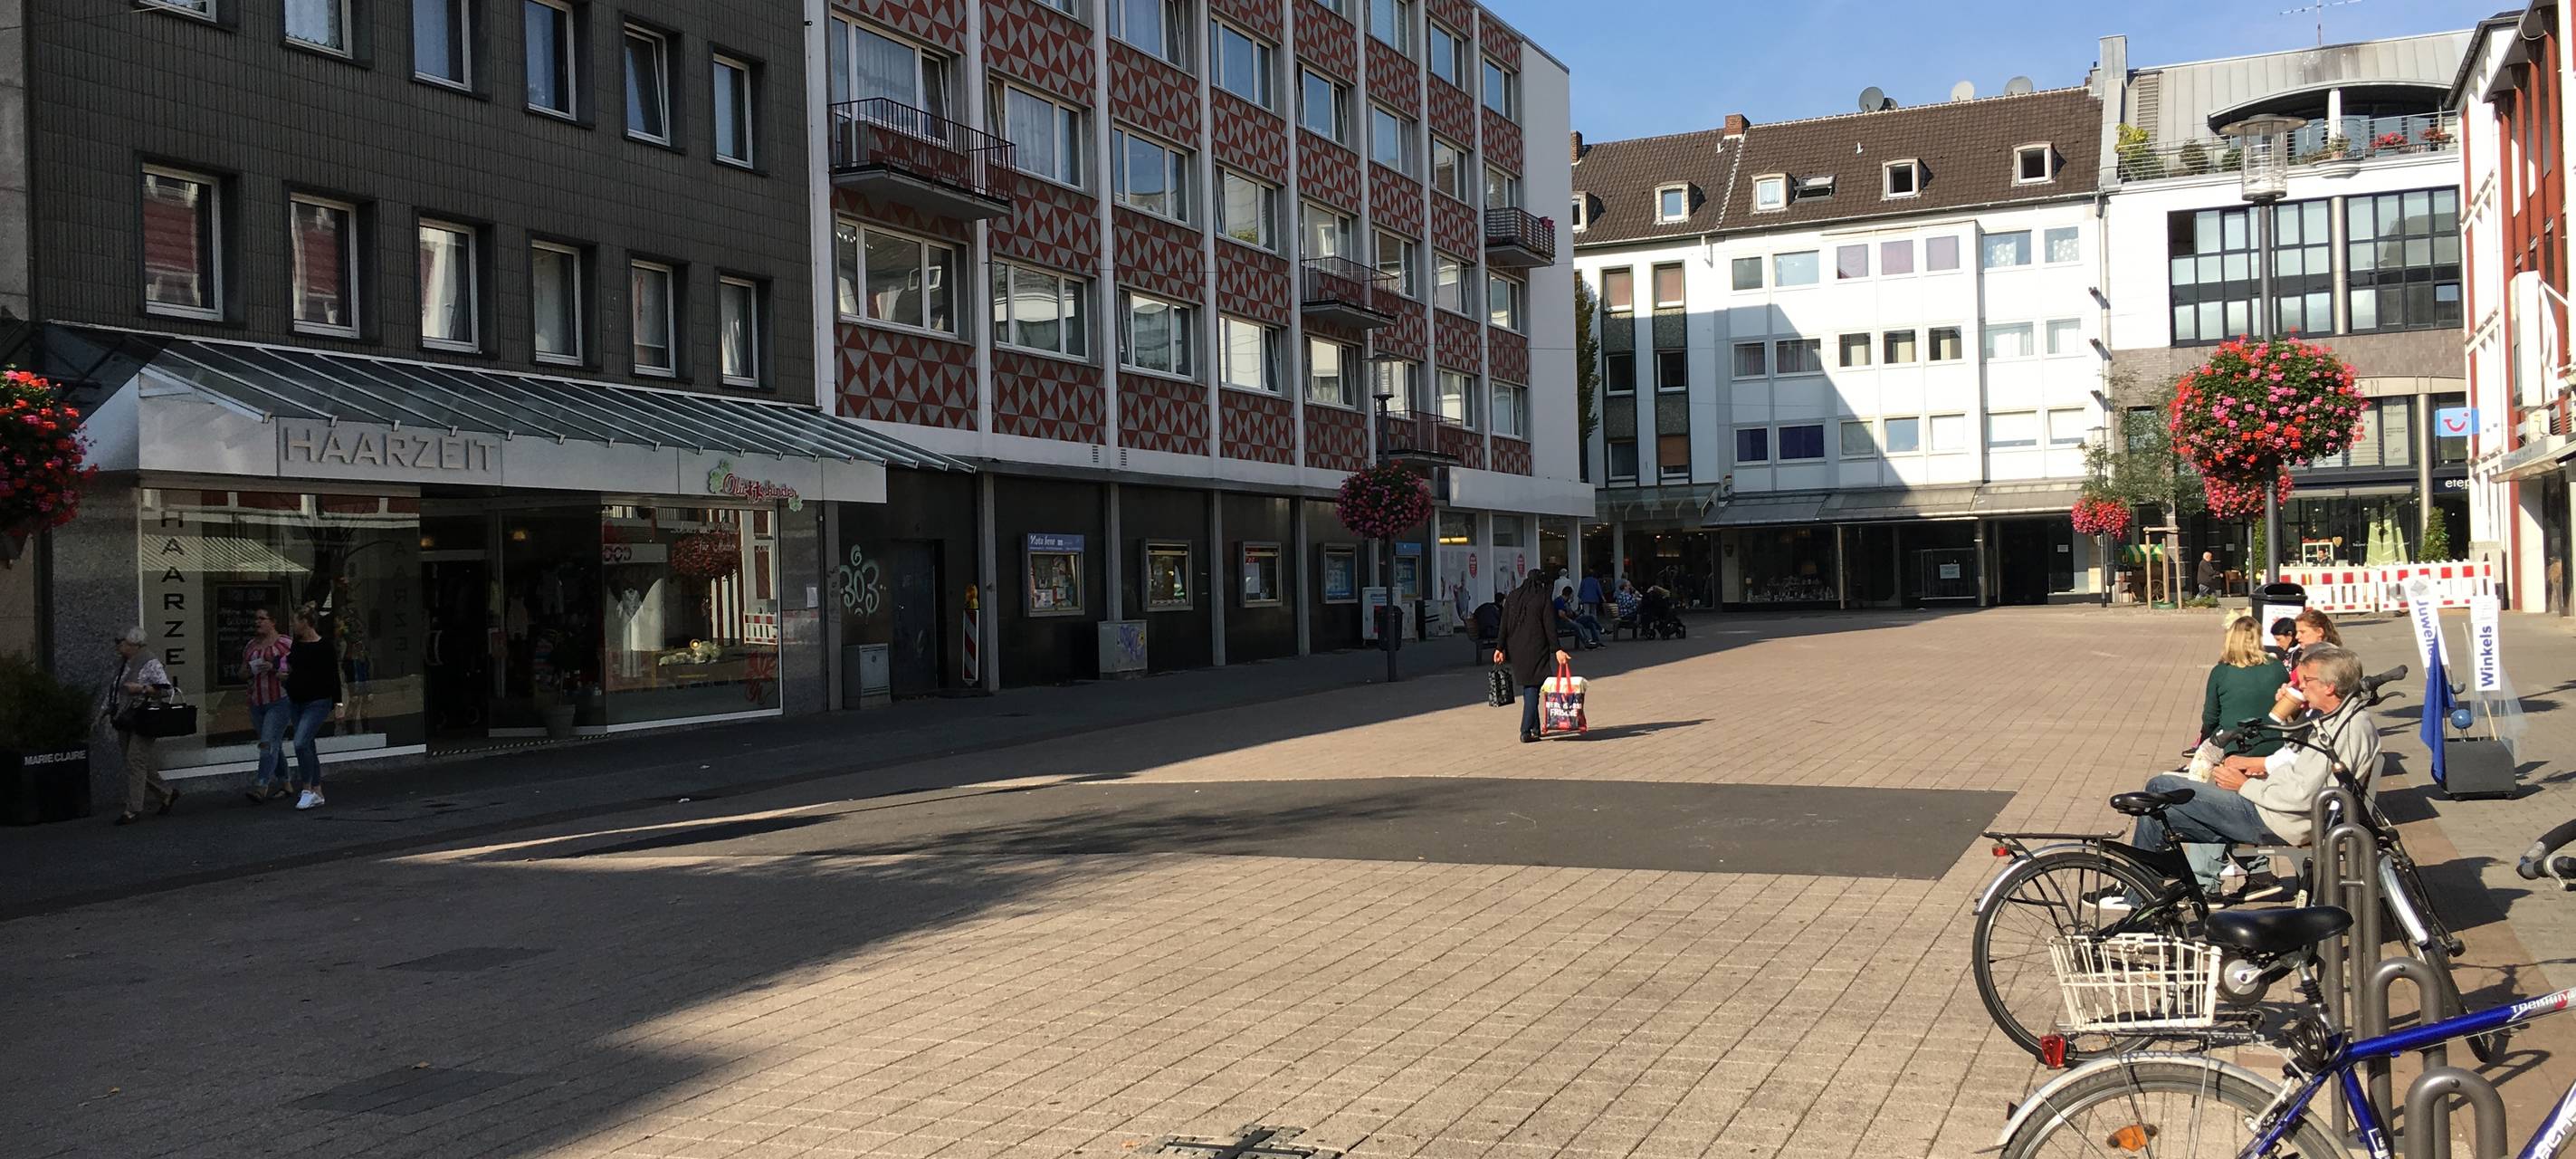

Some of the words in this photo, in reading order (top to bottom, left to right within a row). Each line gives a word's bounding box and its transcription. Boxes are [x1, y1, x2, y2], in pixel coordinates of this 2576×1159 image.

[283, 426, 496, 472] HAARZEIT
[161, 510, 186, 692] HAARZEI
[2416, 599, 2435, 660] Juweli
[2479, 625, 2495, 687] Winkels
[24, 753, 54, 766] MARIE
[54, 750, 87, 762] CLAIRE
